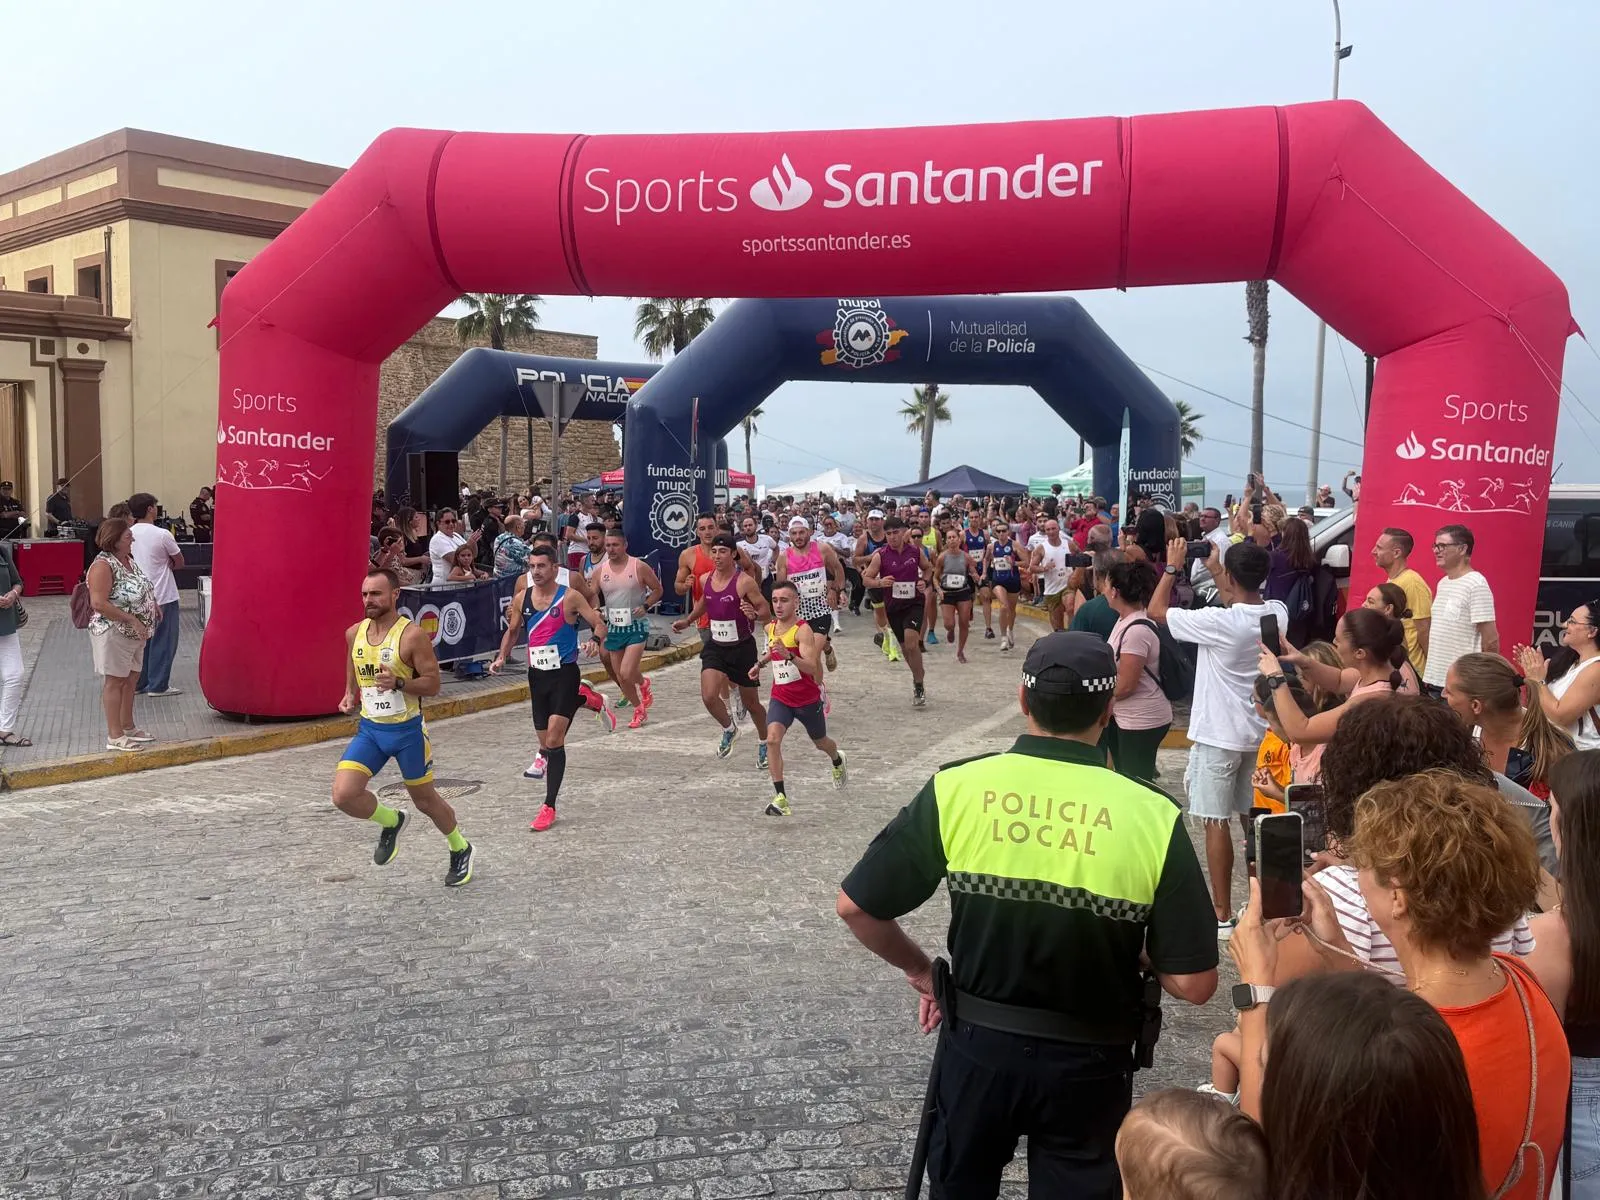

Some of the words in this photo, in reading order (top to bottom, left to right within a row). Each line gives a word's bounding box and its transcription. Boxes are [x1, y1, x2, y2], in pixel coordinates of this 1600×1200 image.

[584, 168, 738, 225] Sports
[823, 153, 1103, 208] Santander
[742, 231, 911, 256] sportssantander.es
[838, 298, 881, 310] mupol
[950, 320, 1027, 336] Mutualidad
[949, 338, 967, 353] de
[970, 338, 982, 353] la
[986, 338, 1036, 353] Policía
[232, 388, 297, 414] Sports
[1443, 394, 1529, 425] Sports
[227, 425, 335, 451] Santander
[1430, 437, 1550, 467] Santander
[647, 464, 706, 479] fundacón
[1129, 467, 1180, 481] fundación
[1139, 479, 1173, 494] mupol
[374, 701, 392, 710] 702
[983, 790, 1113, 831] POLICIA
[992, 819, 1096, 857] LOCAL
